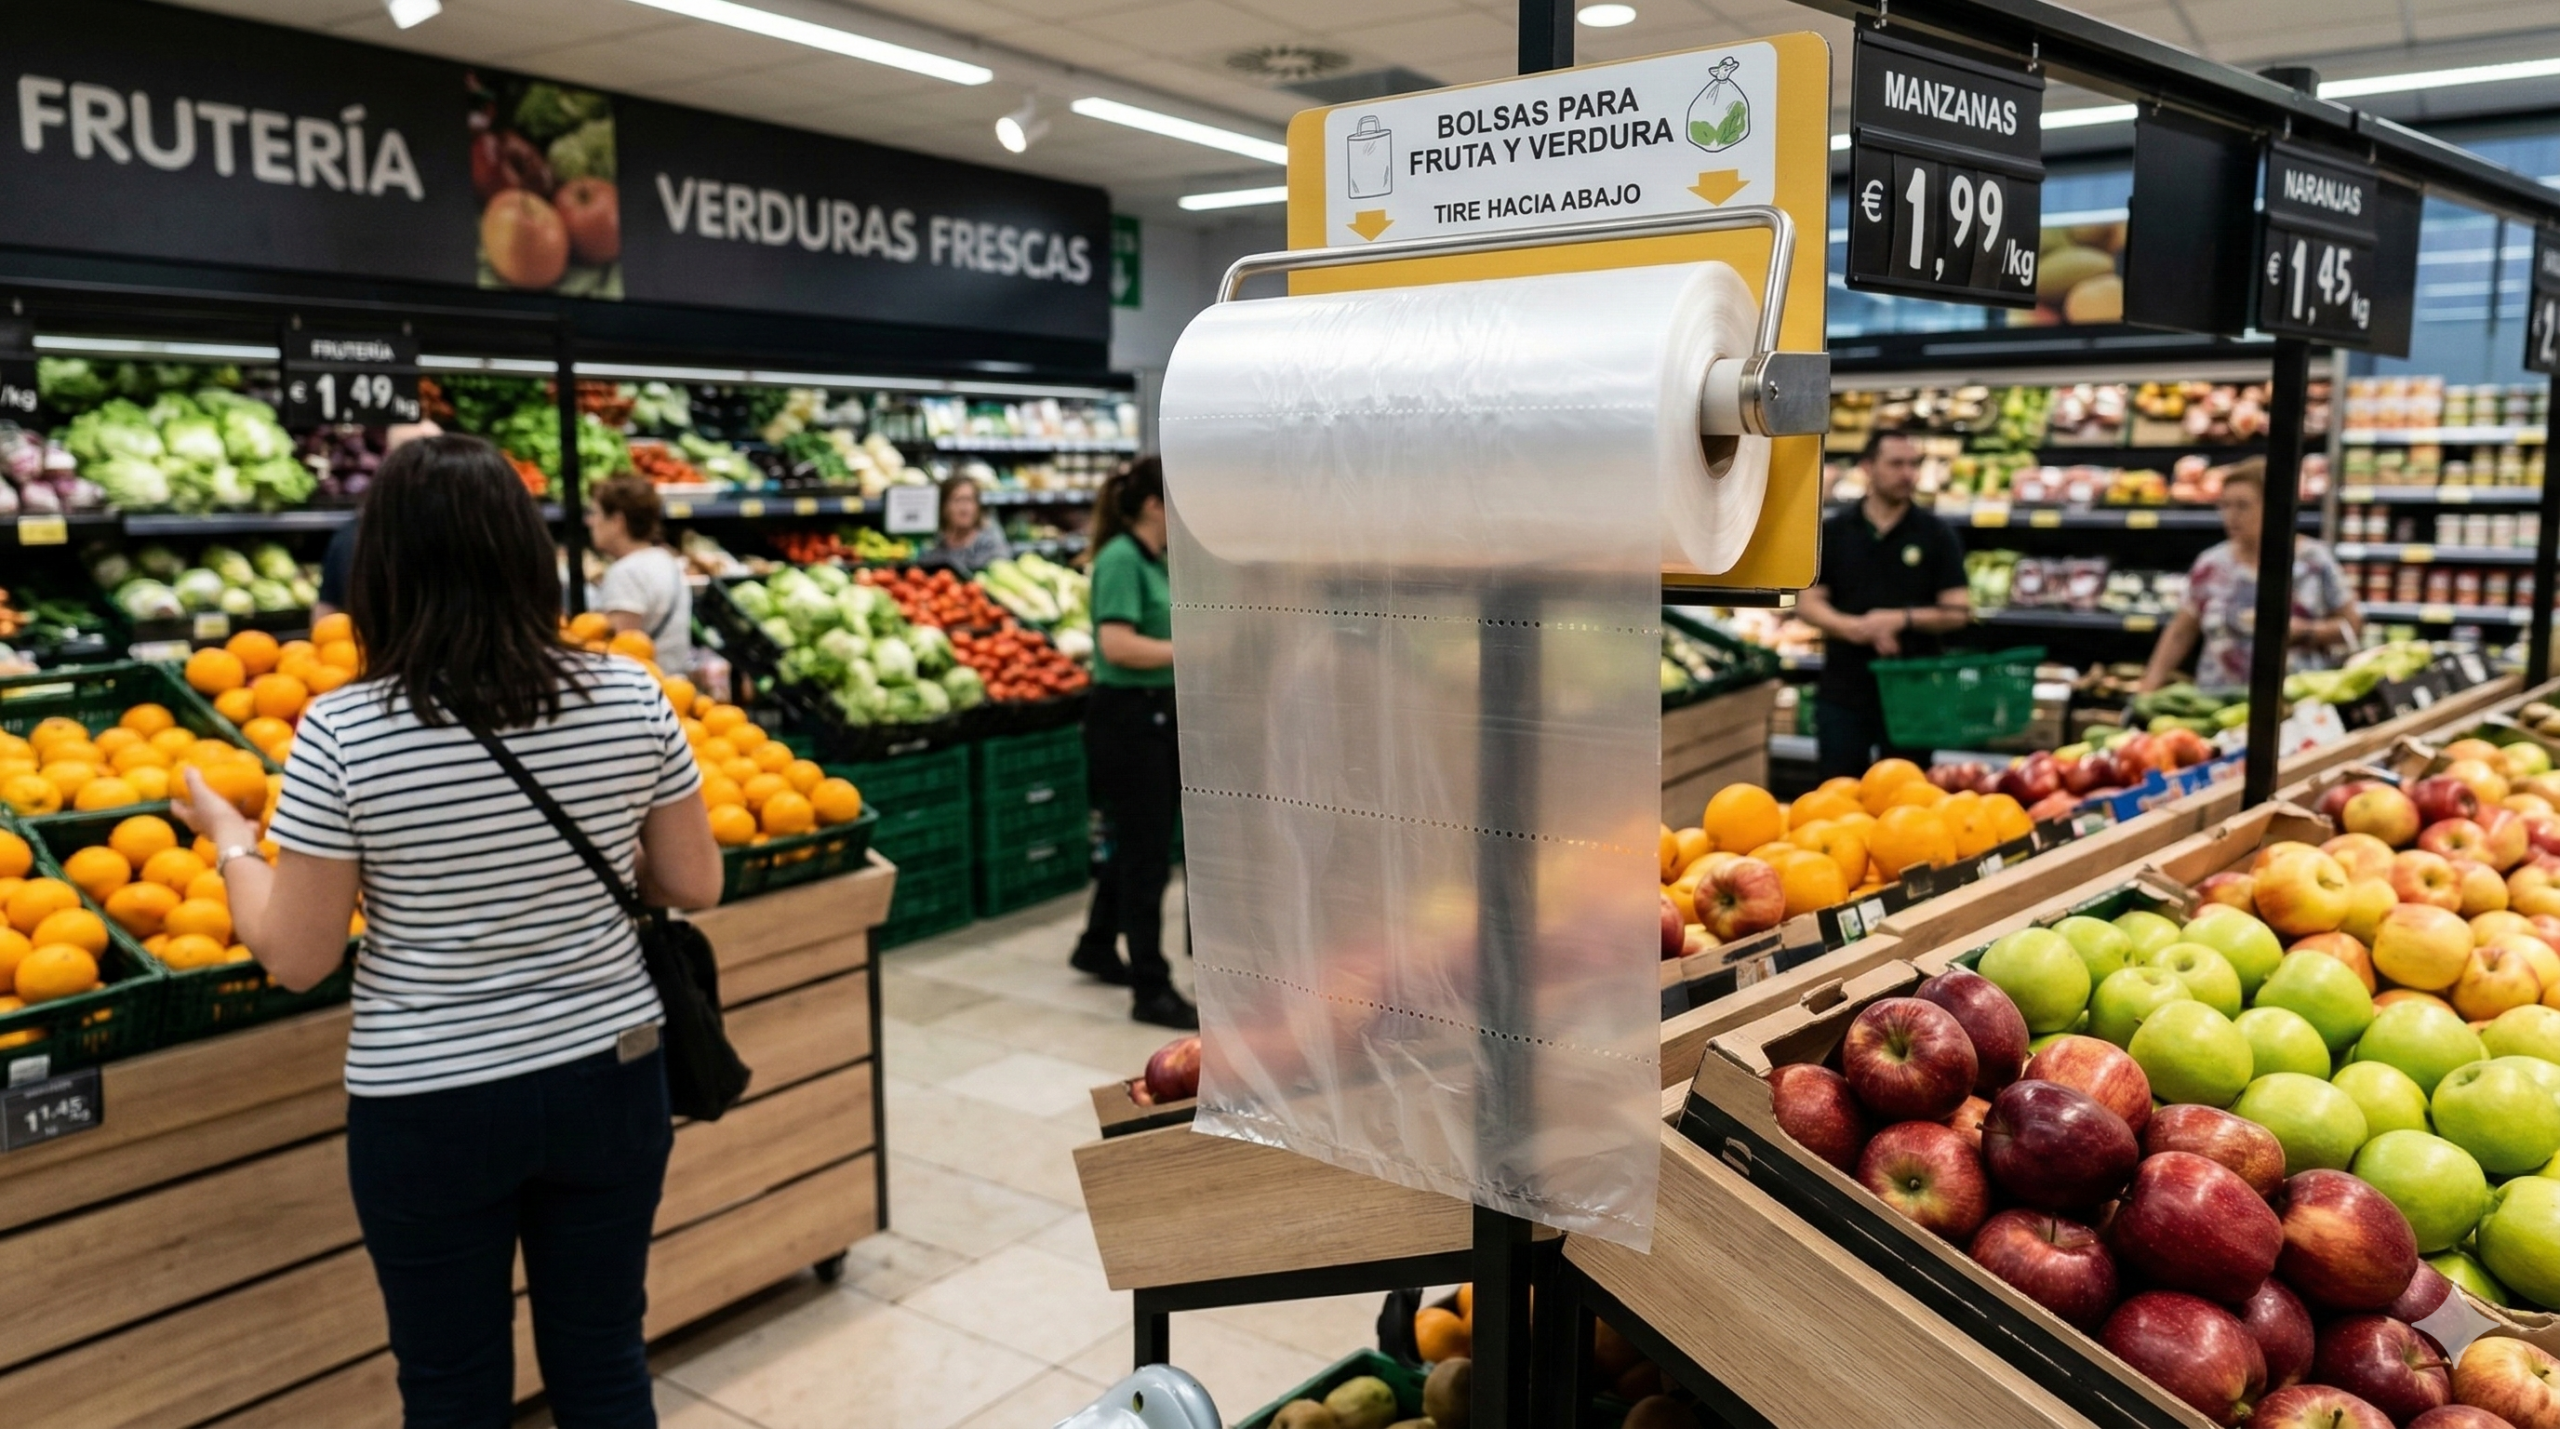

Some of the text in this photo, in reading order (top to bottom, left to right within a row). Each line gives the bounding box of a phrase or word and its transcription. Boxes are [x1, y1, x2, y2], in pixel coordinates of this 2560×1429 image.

[1438, 87, 1639, 139] BOLSAS PARA
[1885, 70, 2017, 136] MANZANAS
[18, 73, 424, 201] FRUTERÍA
[1410, 117, 1674, 176] FRUTA Y VERDURA
[1434, 183, 1641, 224] TIRE HACIA ABAJO
[1861, 179, 1884, 223] €
[2284, 168, 2363, 216] NARANJAS
[656, 173, 1092, 285] VERDURAS FRESCAS
